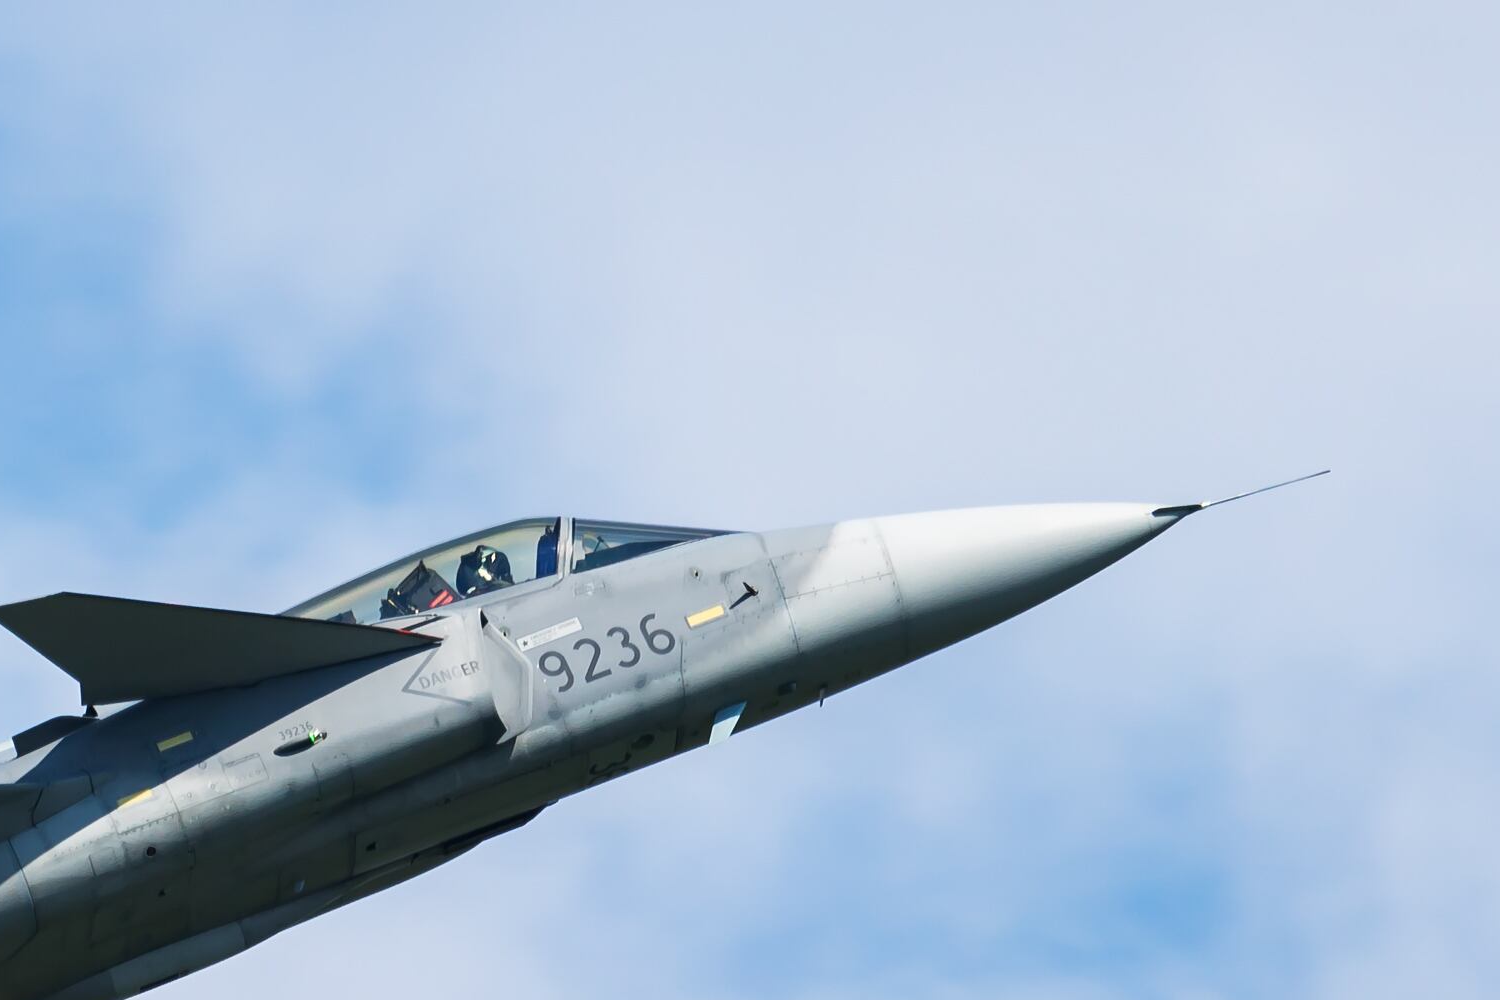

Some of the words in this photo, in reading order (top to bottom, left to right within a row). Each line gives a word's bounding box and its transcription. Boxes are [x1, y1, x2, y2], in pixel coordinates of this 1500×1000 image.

[538, 613, 676, 693] 9236
[418, 660, 480, 690] DANGER
[278, 719, 314, 740] 39236
